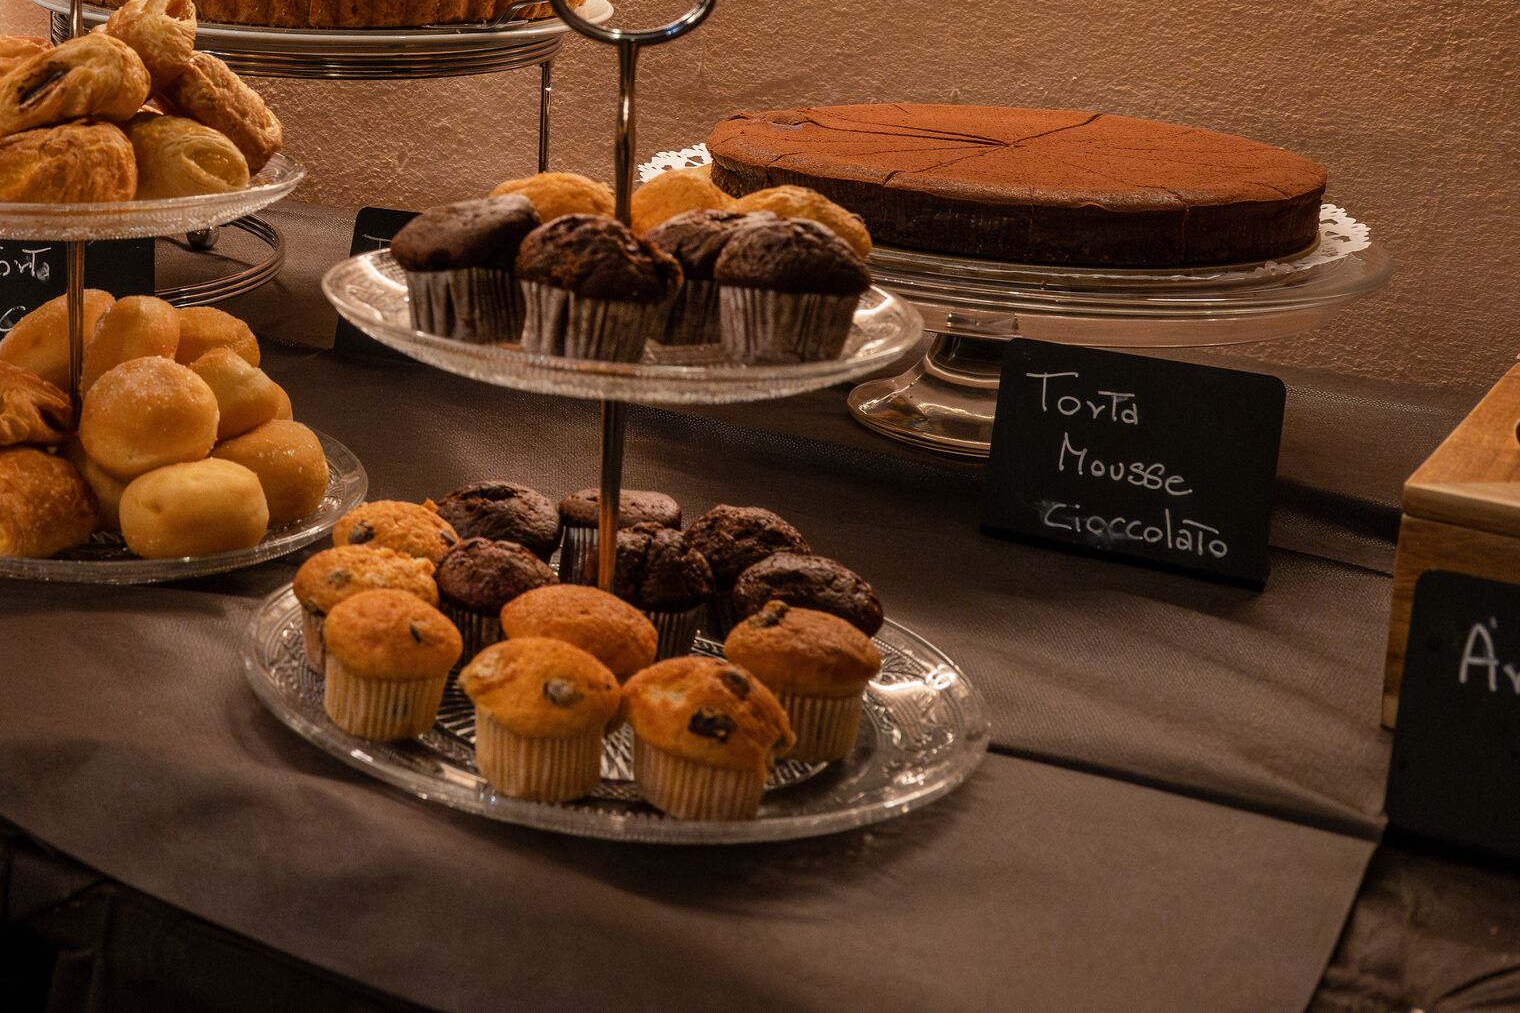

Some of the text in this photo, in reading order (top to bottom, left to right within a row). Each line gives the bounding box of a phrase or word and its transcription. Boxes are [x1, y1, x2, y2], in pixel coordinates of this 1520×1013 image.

[1026, 372, 1139, 426] Torta
[1057, 431, 1193, 497] Mousse
[1041, 498, 1229, 559] Cioccolato
